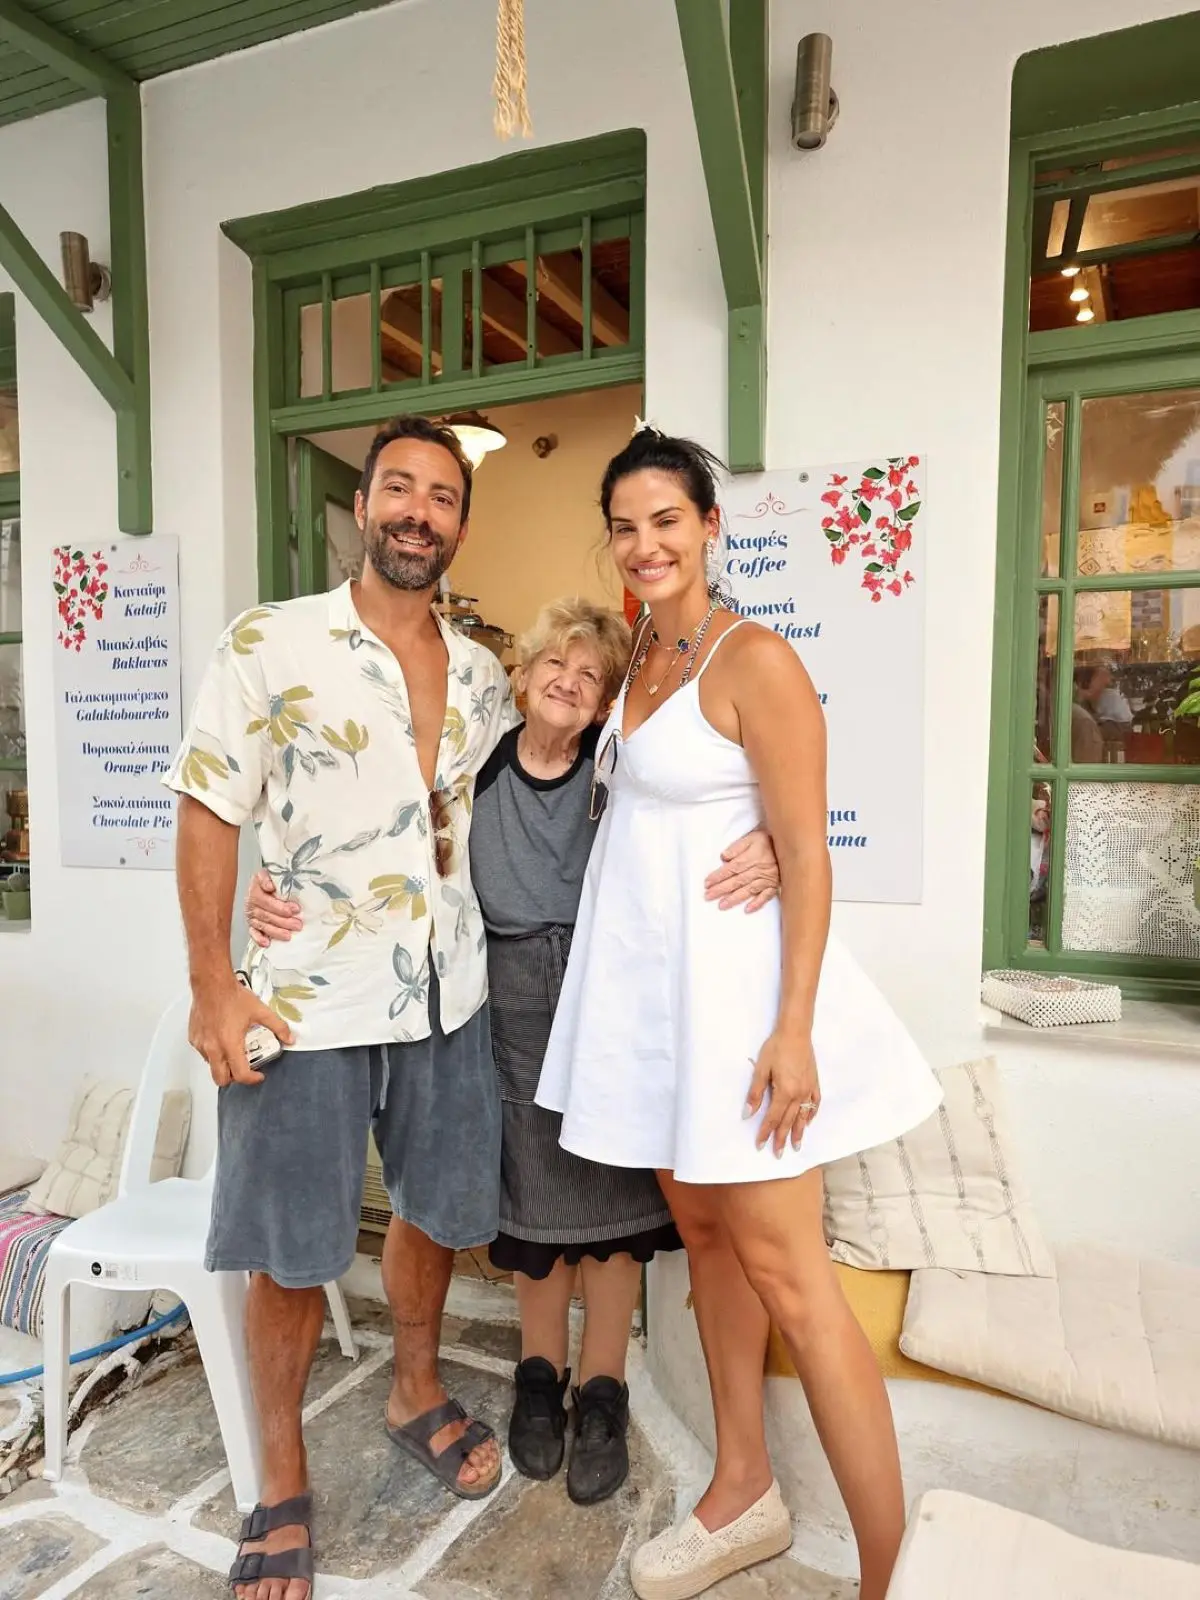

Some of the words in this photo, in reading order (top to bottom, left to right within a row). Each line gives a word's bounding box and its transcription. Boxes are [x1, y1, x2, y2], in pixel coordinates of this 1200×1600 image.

[726, 530, 788, 552] Καφές
[726, 556, 787, 578] Coffee
[124, 601, 167, 618] Kataifi
[97, 635, 168, 652] Μπακλαβάς
[112, 656, 169, 670] Baklavas
[65, 688, 169, 705] Γαλακτομπούρεκο
[76, 707, 169, 721] Galaktoboureko
[82, 741, 170, 758] Πορτοκαλόπιτα
[104, 760, 148, 776] Orange
[151, 760, 171, 773] Pie
[92, 796, 172, 810] Σοκολατόπιτα
[92, 814, 150, 828] Chocolate
[153, 815, 172, 828] Pie
